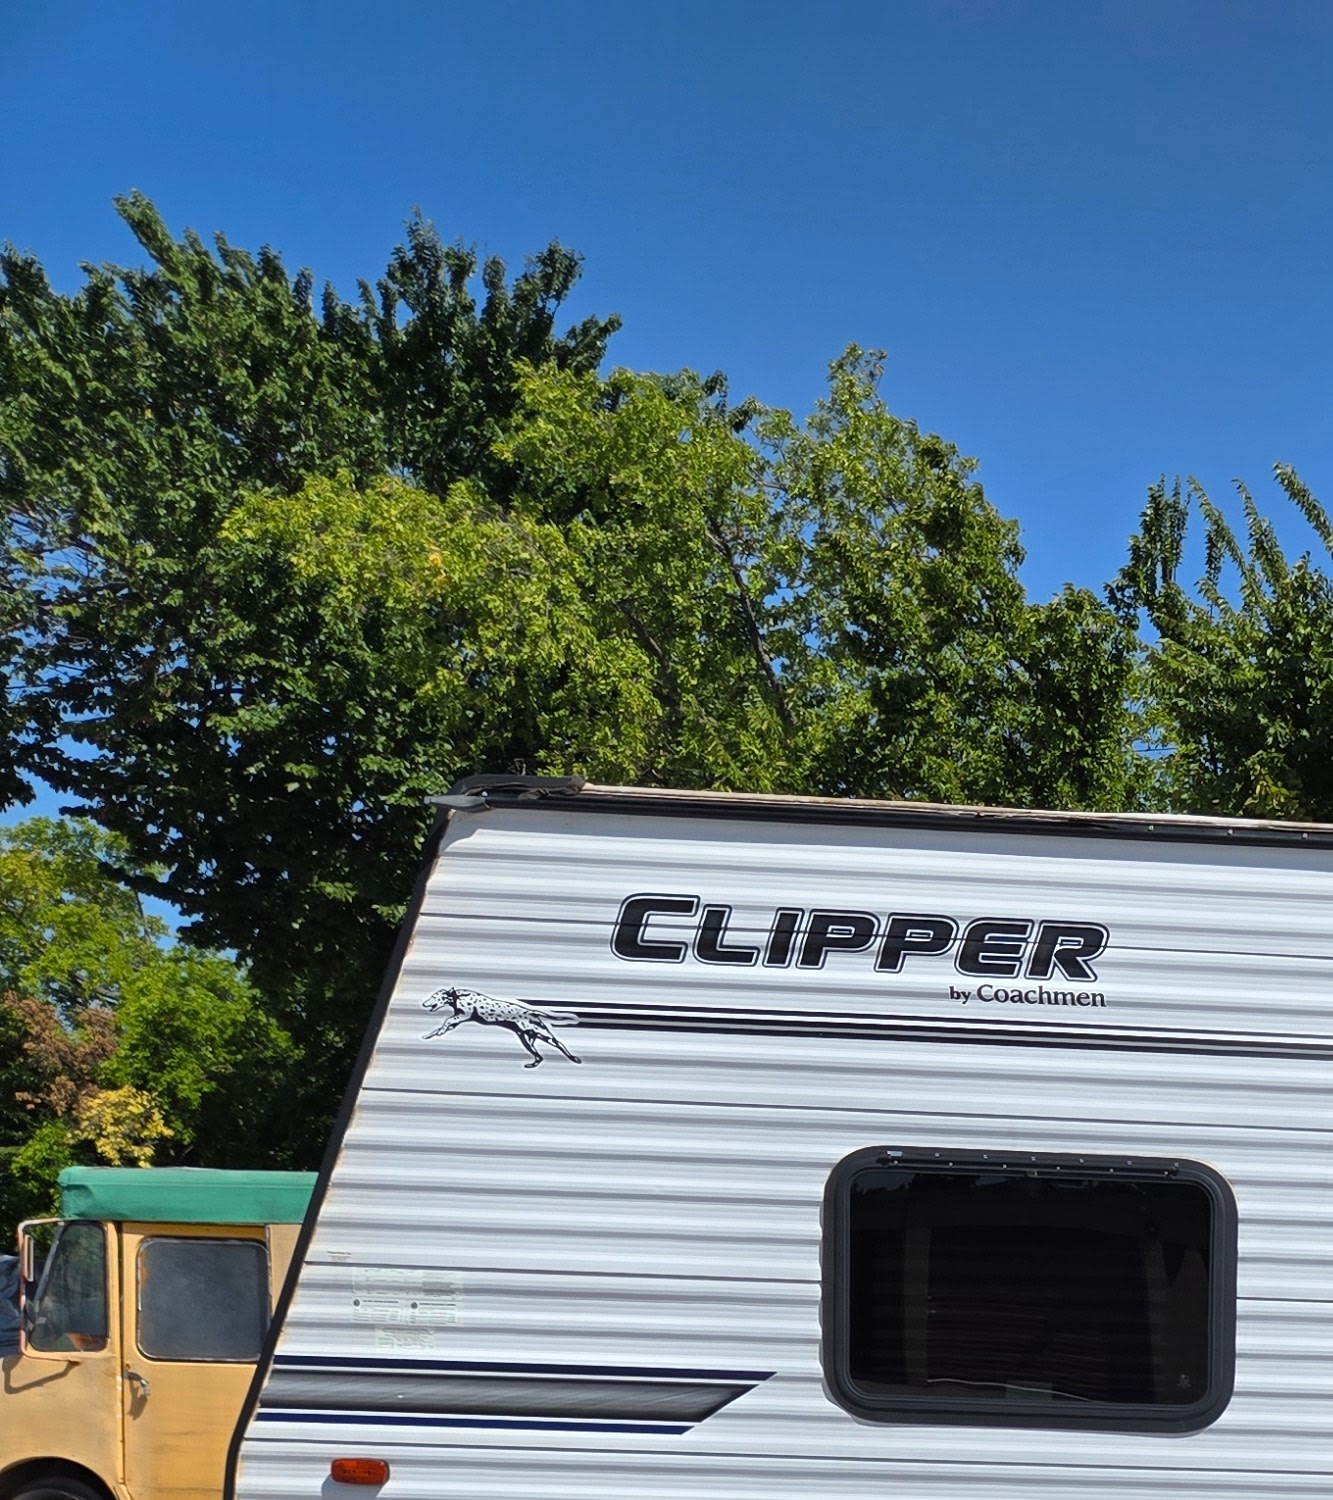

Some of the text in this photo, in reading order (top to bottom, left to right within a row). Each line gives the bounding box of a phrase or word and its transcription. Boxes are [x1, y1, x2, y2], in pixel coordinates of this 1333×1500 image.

[610, 892, 1110, 983] CLIPPER
[949, 984, 1107, 1007] by Coachmen
